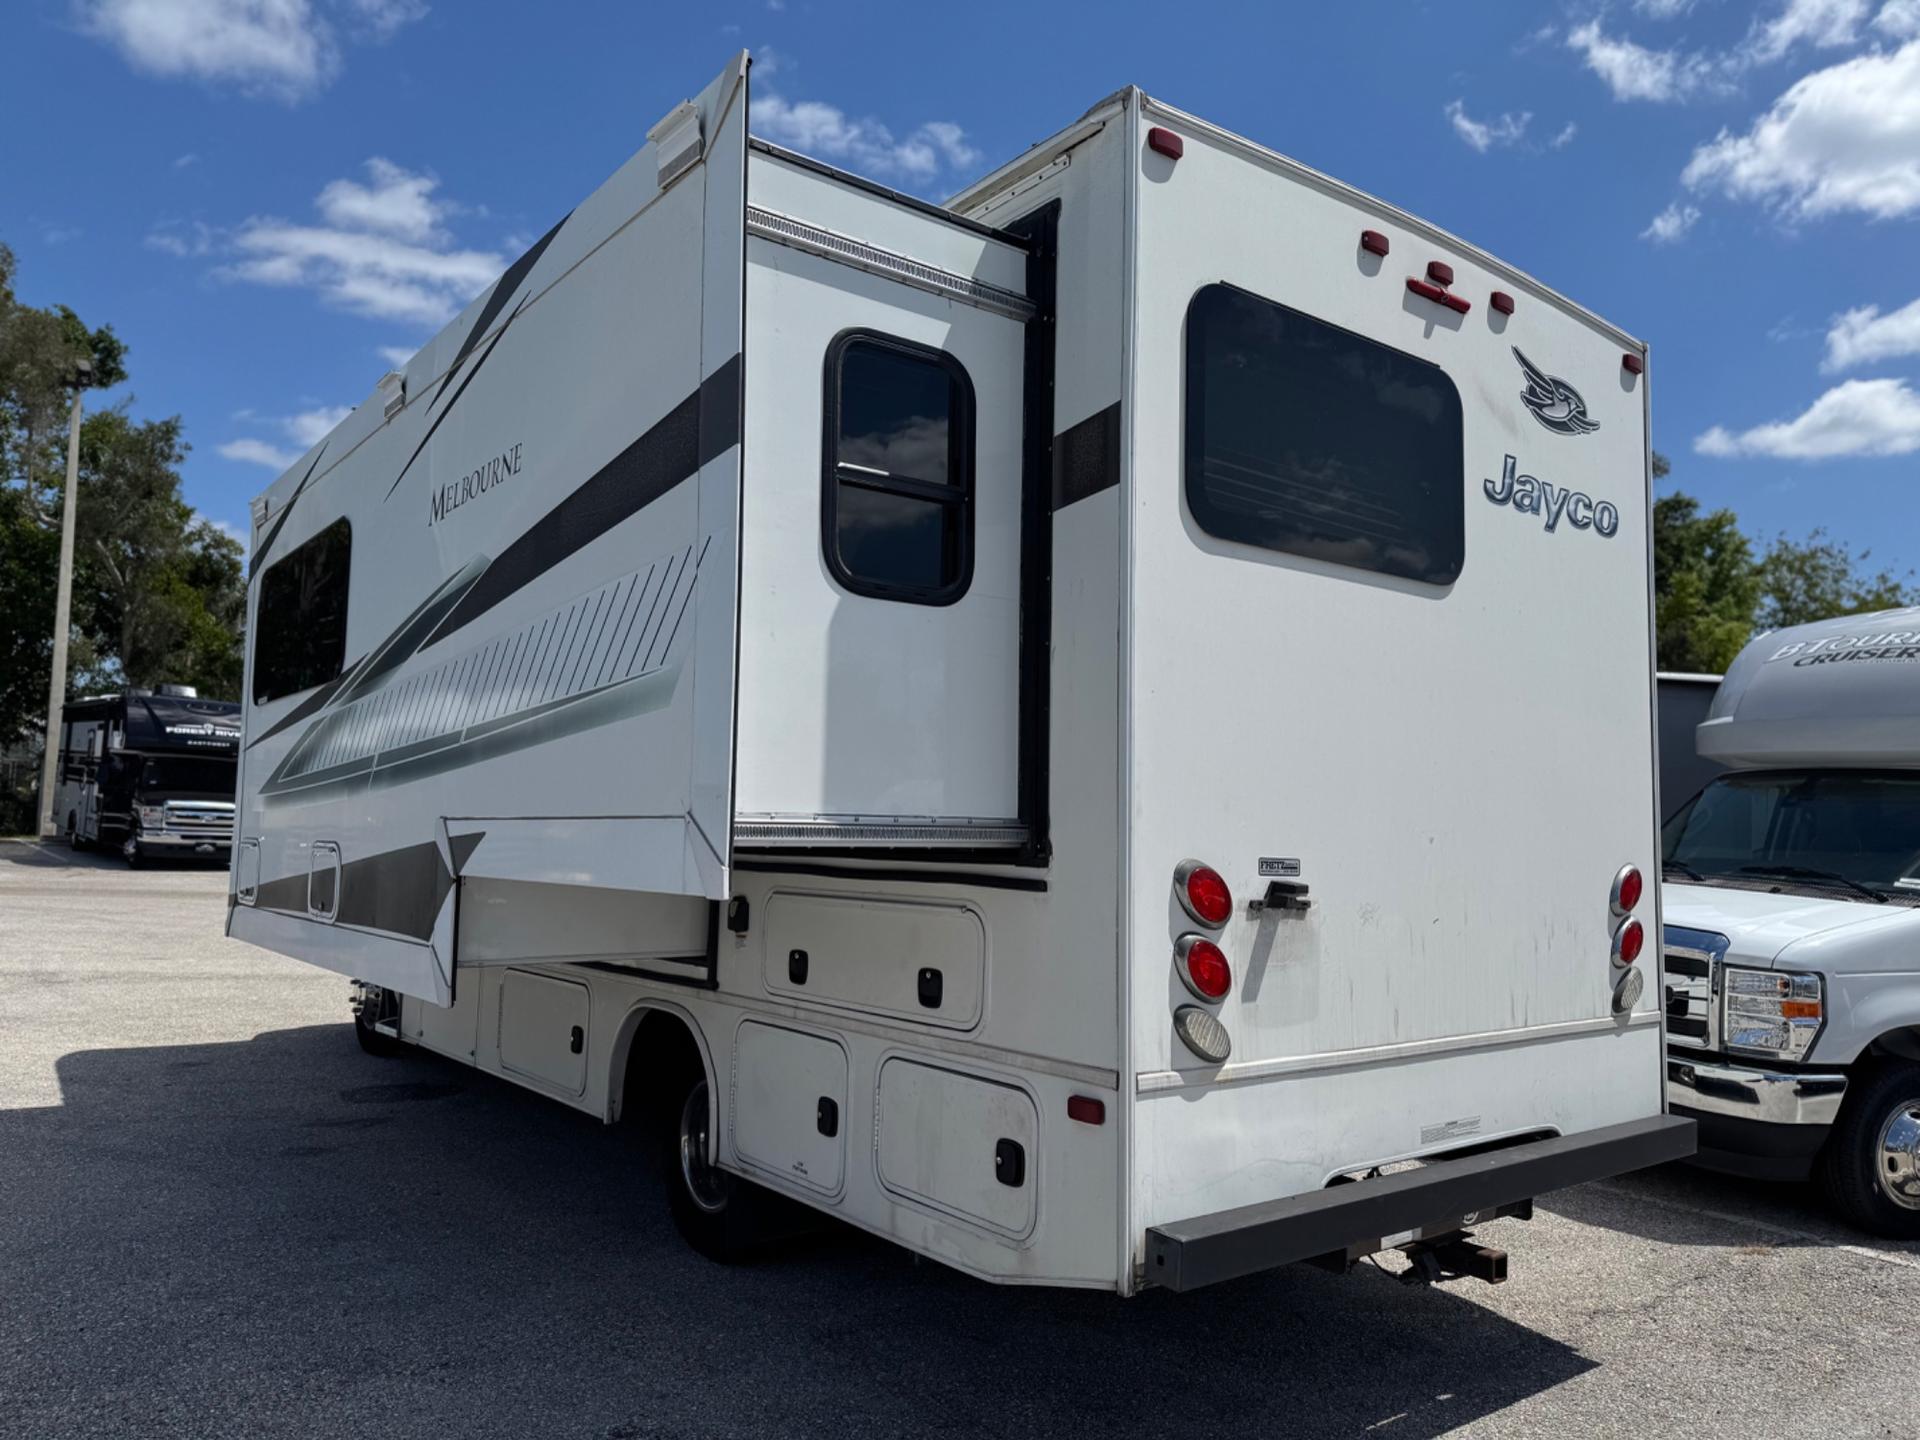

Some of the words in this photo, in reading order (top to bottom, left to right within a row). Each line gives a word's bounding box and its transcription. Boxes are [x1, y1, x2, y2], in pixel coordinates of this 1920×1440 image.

[428, 442, 522, 527] MELBOURNE
[1483, 454, 1619, 538] Jayco
[1793, 647, 1920, 667] CRUISER
[166, 726, 213, 735] FOREST
[215, 730, 241, 738] RIVE
